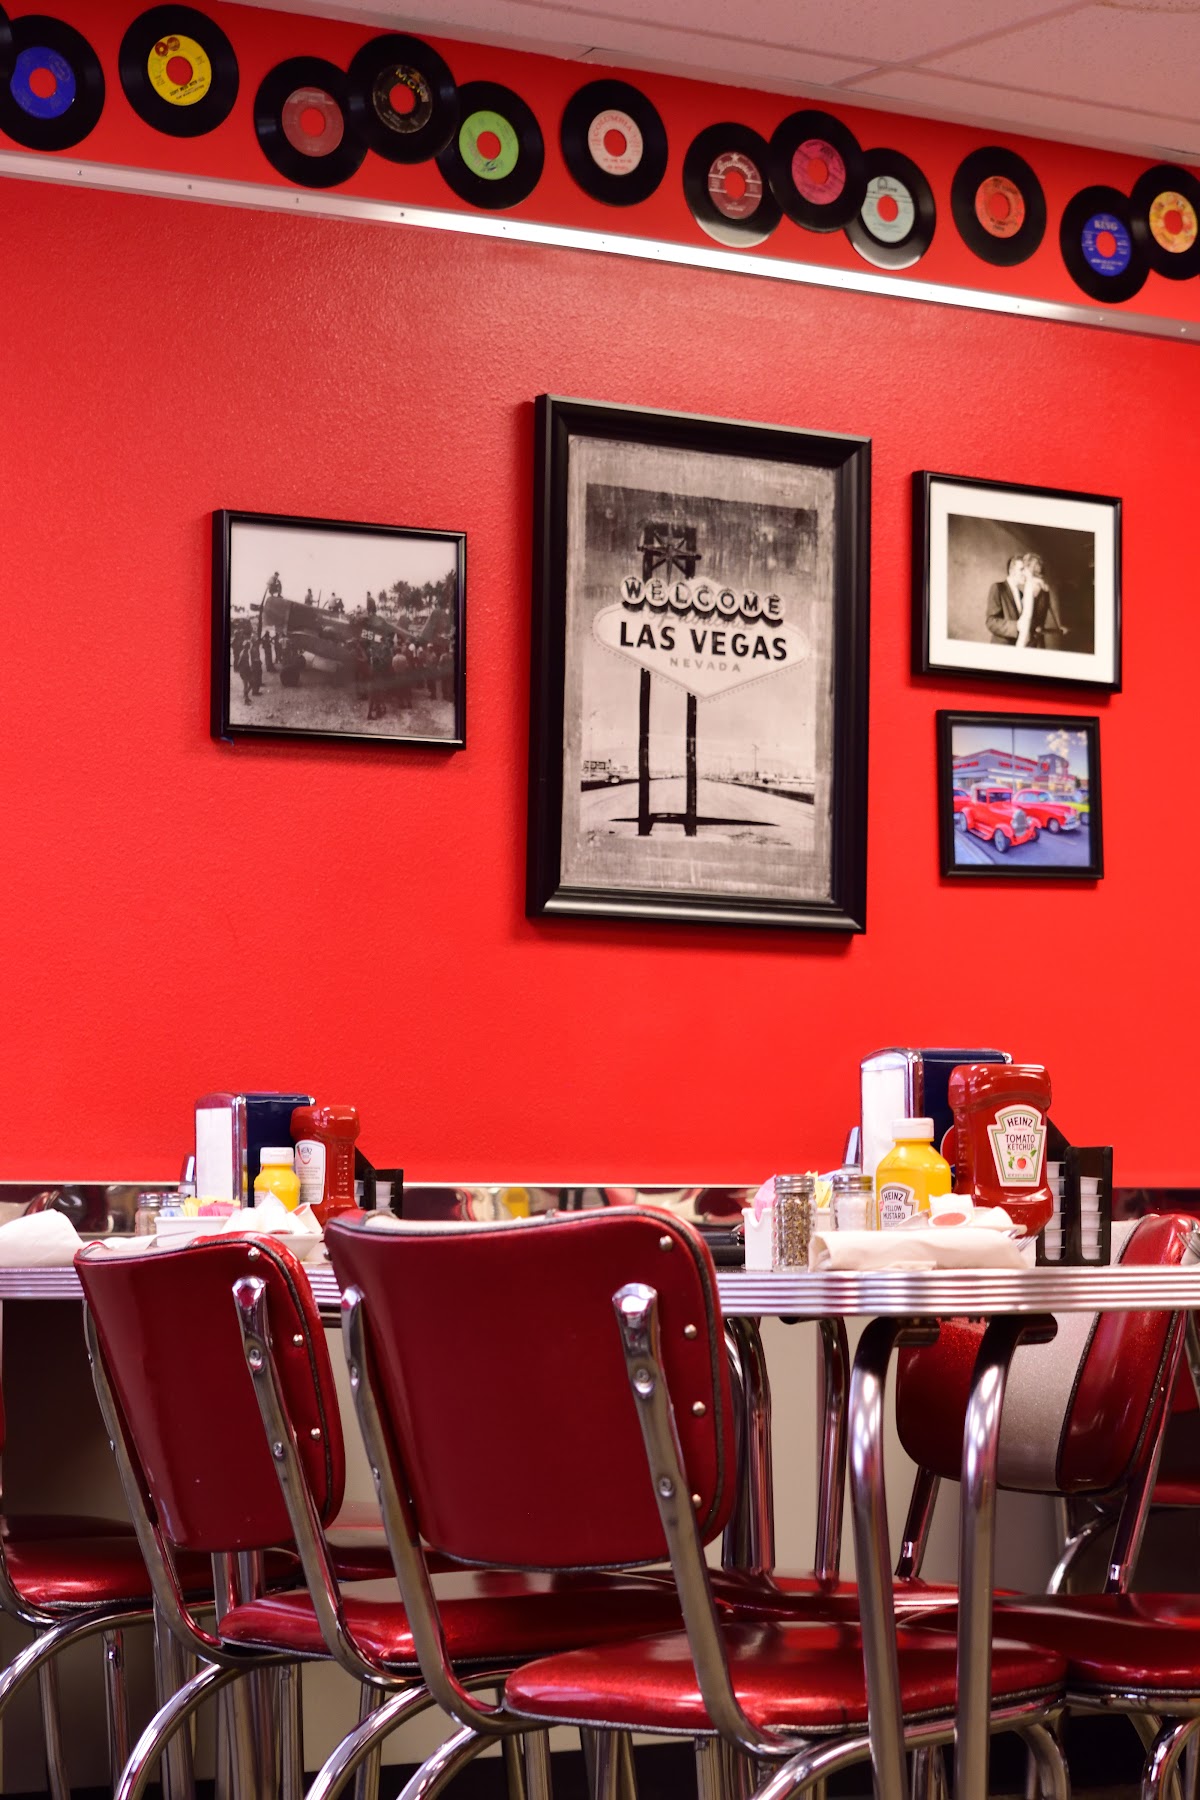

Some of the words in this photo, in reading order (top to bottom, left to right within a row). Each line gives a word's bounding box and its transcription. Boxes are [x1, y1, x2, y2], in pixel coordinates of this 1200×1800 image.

[1094, 220, 1119, 231] KING
[624, 579, 780, 615] WELCOME
[361, 629, 374, 641] 25
[620, 622, 675, 650] LAS
[690, 629, 787, 661] VEGAS
[669, 657, 741, 673] NEVADA
[1007, 1116, 1033, 1128] HEINZ
[1005, 1134, 1035, 1143] TOMATO
[1007, 1143, 1035, 1151] KETCHUP
[883, 1191, 904, 1202] HEINZ
[885, 1204, 903, 1212] YELLOW
[883, 1212, 906, 1220] MUSTARD
